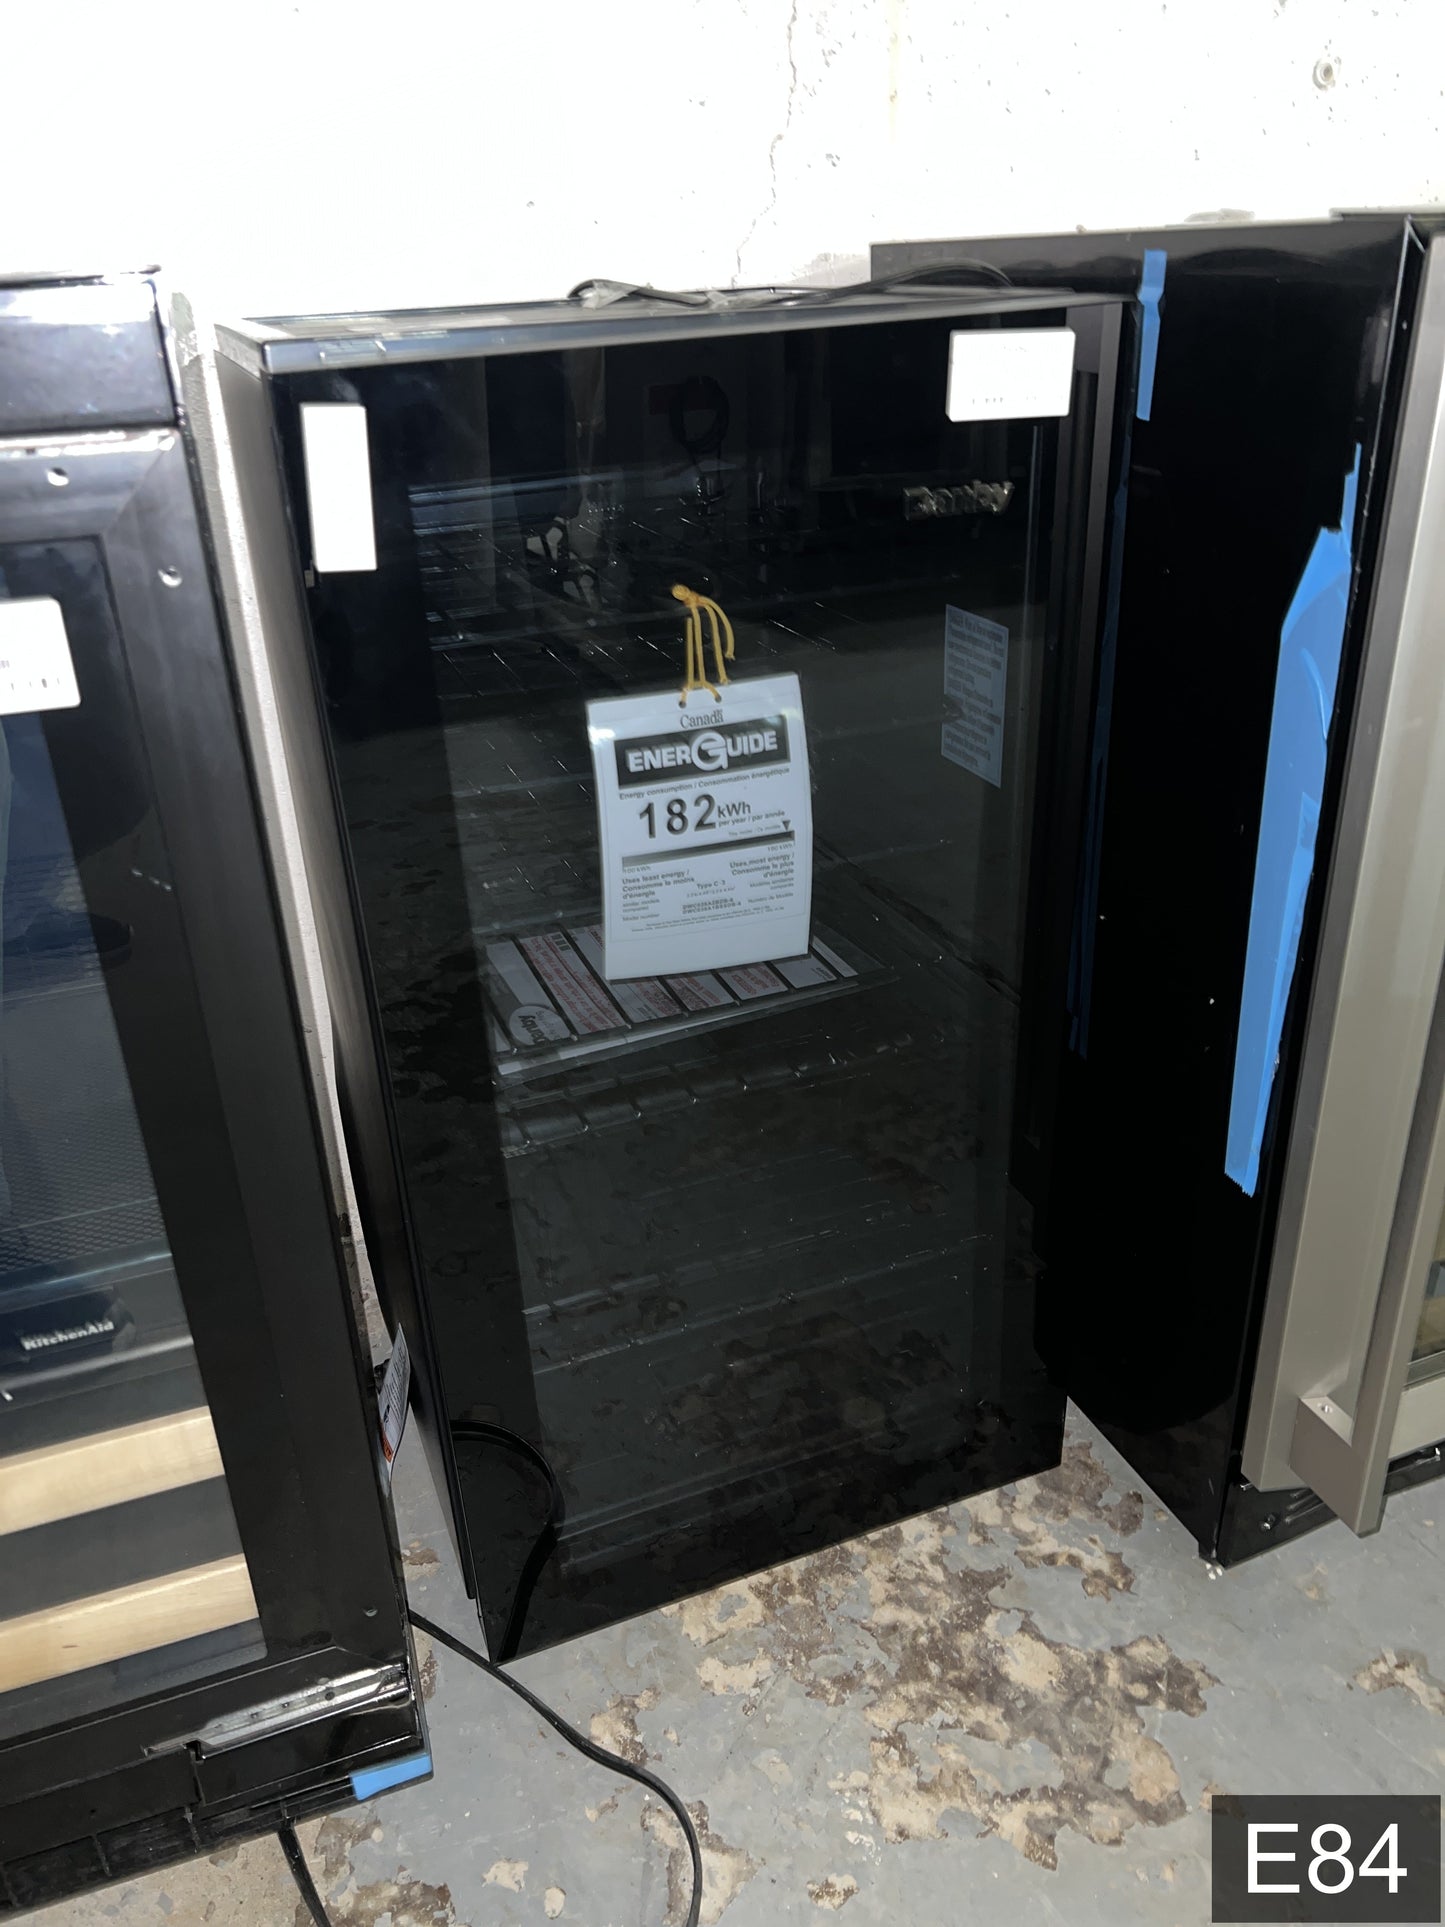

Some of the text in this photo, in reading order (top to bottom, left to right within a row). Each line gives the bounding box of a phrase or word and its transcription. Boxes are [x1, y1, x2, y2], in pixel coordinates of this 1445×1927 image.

[680, 709, 724, 728] Canada
[625, 729, 779, 773] ENERGUIDE
[619, 790, 644, 801] Energy
[646, 782, 692, 796] consumption
[698, 772, 750, 787] Consommation
[639, 794, 716, 839] 182
[717, 800, 751, 817] kWh
[764, 809, 785, 818] année
[730, 859, 747, 868] Uses
[748, 856, 766, 864] most
[767, 853, 790, 863] energy
[732, 864, 770, 875] Consomme
[780, 859, 794, 868] plus
[622, 877, 640, 885] Uses
[642, 873, 659, 882] least
[660, 870, 684, 880] energy
[622, 880, 662, 892] Consomme
[21, 1316, 115, 1351] KitchenAid
